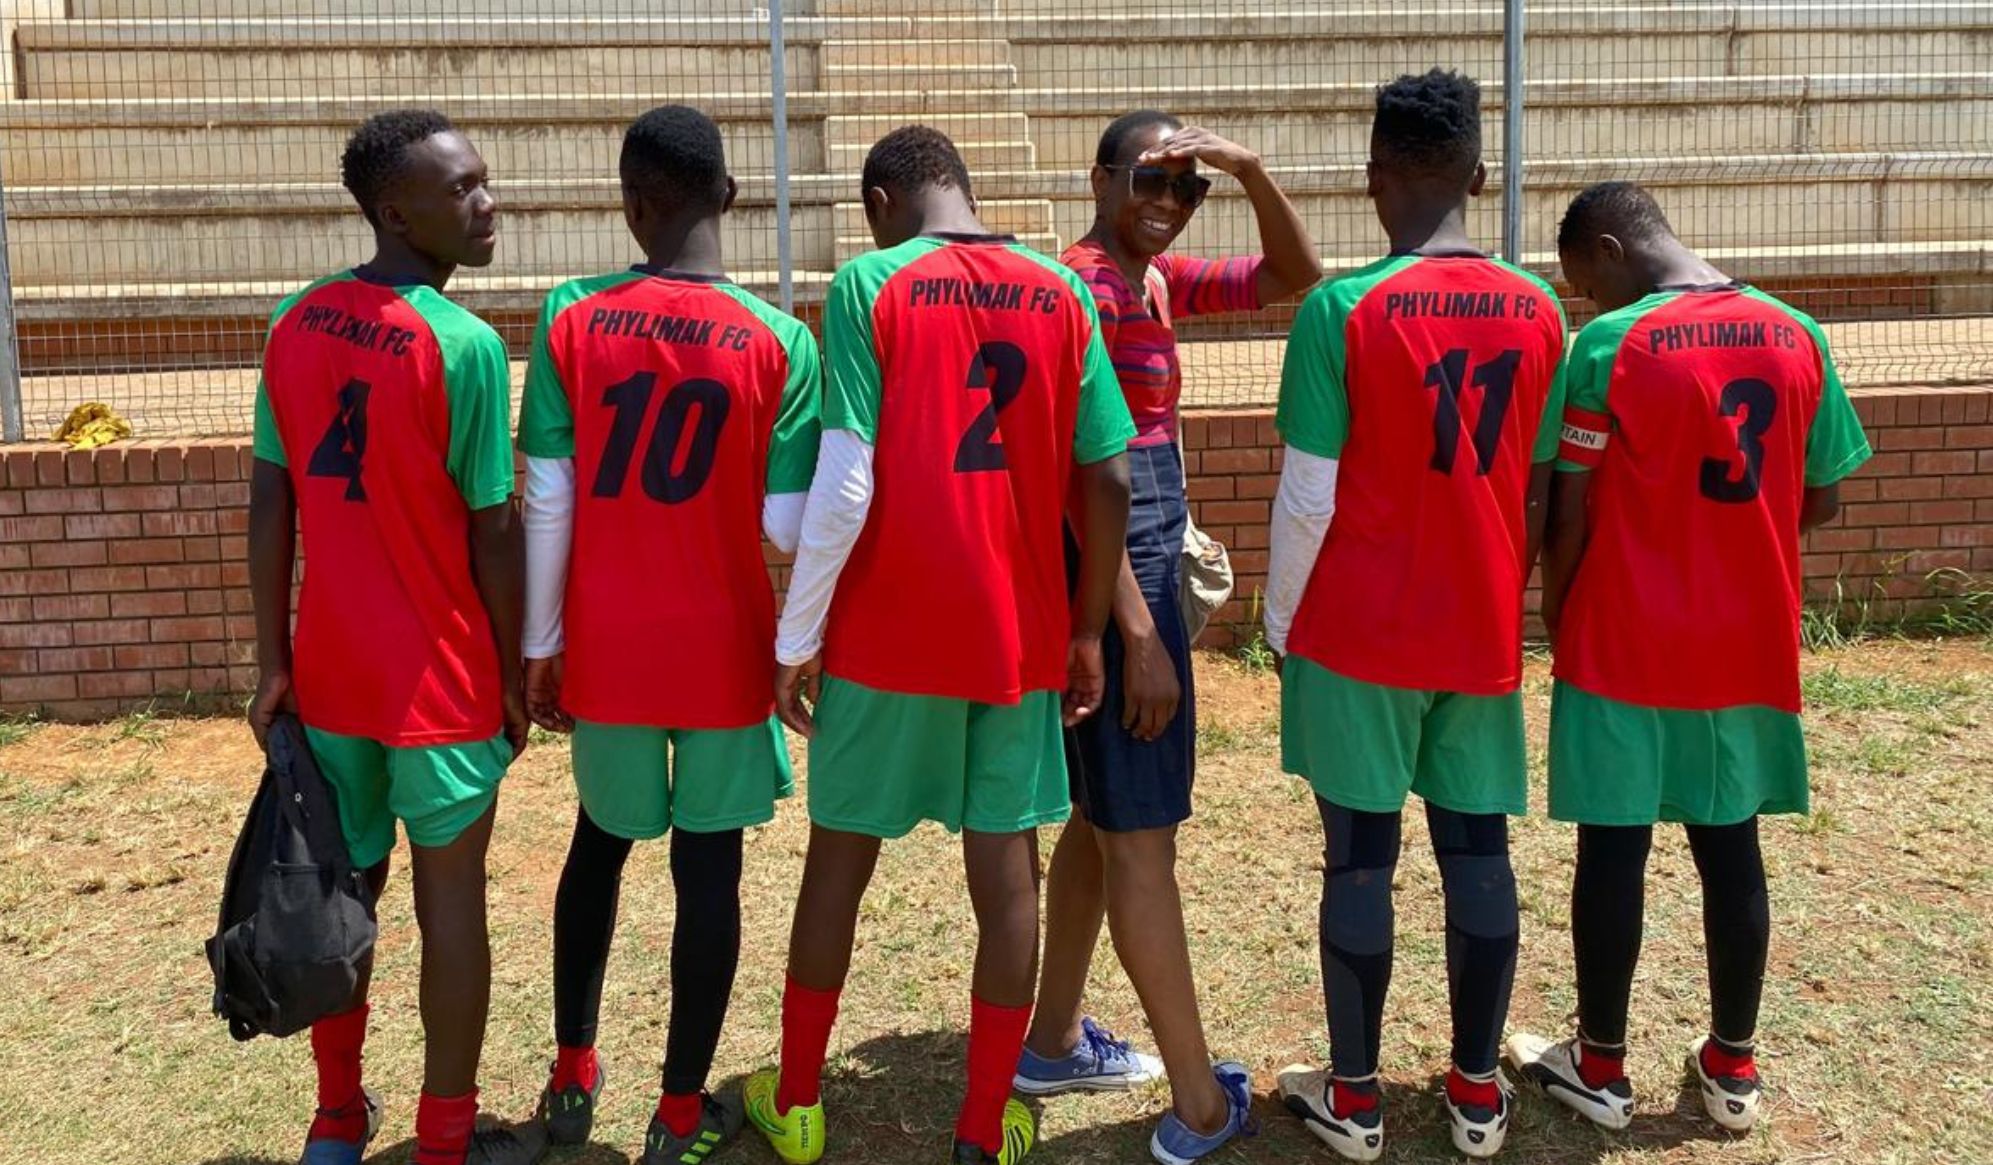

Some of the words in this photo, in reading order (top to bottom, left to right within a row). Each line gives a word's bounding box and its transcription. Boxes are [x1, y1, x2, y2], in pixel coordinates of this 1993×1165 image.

[911, 278, 1025, 310] PHYLIMAK
[1029, 286, 1060, 314] FC
[1385, 291, 1507, 320] PHYLIMAK
[1513, 294, 1536, 320] FC
[382, 326, 416, 357] FC
[588, 308, 717, 346] PHYLIMAK
[717, 324, 752, 352] FC
[1650, 321, 1765, 355] PHYLIMAK
[1772, 324, 1796, 348] FC
[953, 341, 1027, 473] 2
[1424, 349, 1522, 476] 11
[306, 378, 371, 500] 4
[592, 371, 728, 505] 10
[1562, 425, 1597, 445] TAIN
[1701, 378, 1778, 501] 3
